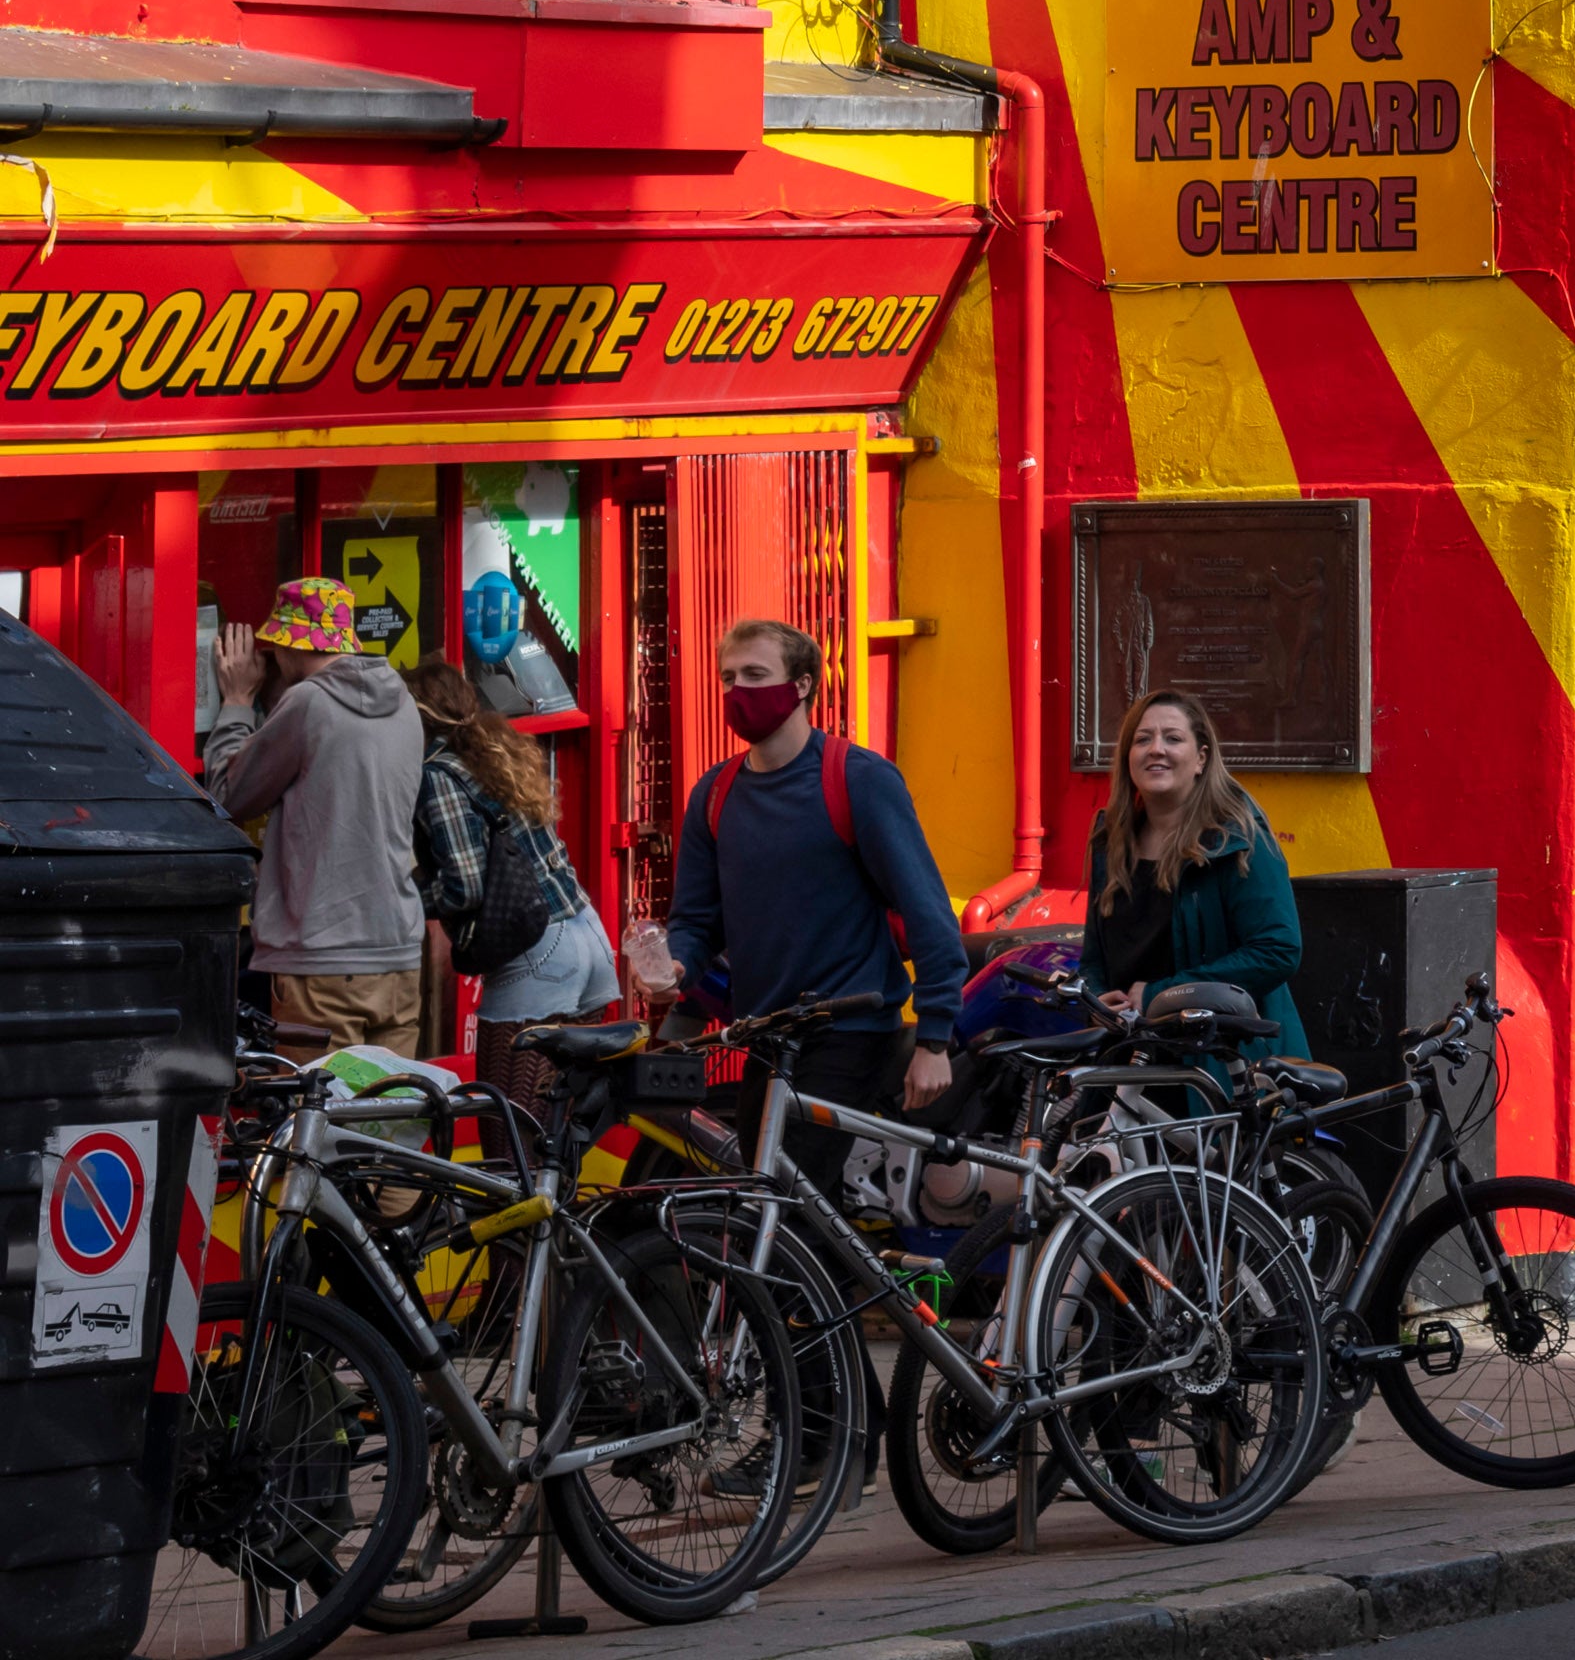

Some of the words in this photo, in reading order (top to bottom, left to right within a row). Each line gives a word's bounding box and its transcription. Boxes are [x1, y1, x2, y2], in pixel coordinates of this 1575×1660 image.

[1135, 79, 1461, 162] KEYBOARD
[1176, 176, 1418, 257] CENTRE
[355, 282, 666, 386] CENTRE
[664, 297, 788, 362] 01273
[792, 294, 940, 359] 672977
[356, 623, 378, 631] SERVICE
[361, 615, 393, 624] COLLECTION
[514, 553, 540, 591] PAY
[537, 589, 575, 653] LATER!
[596, 1439, 630, 1455] GIANT
